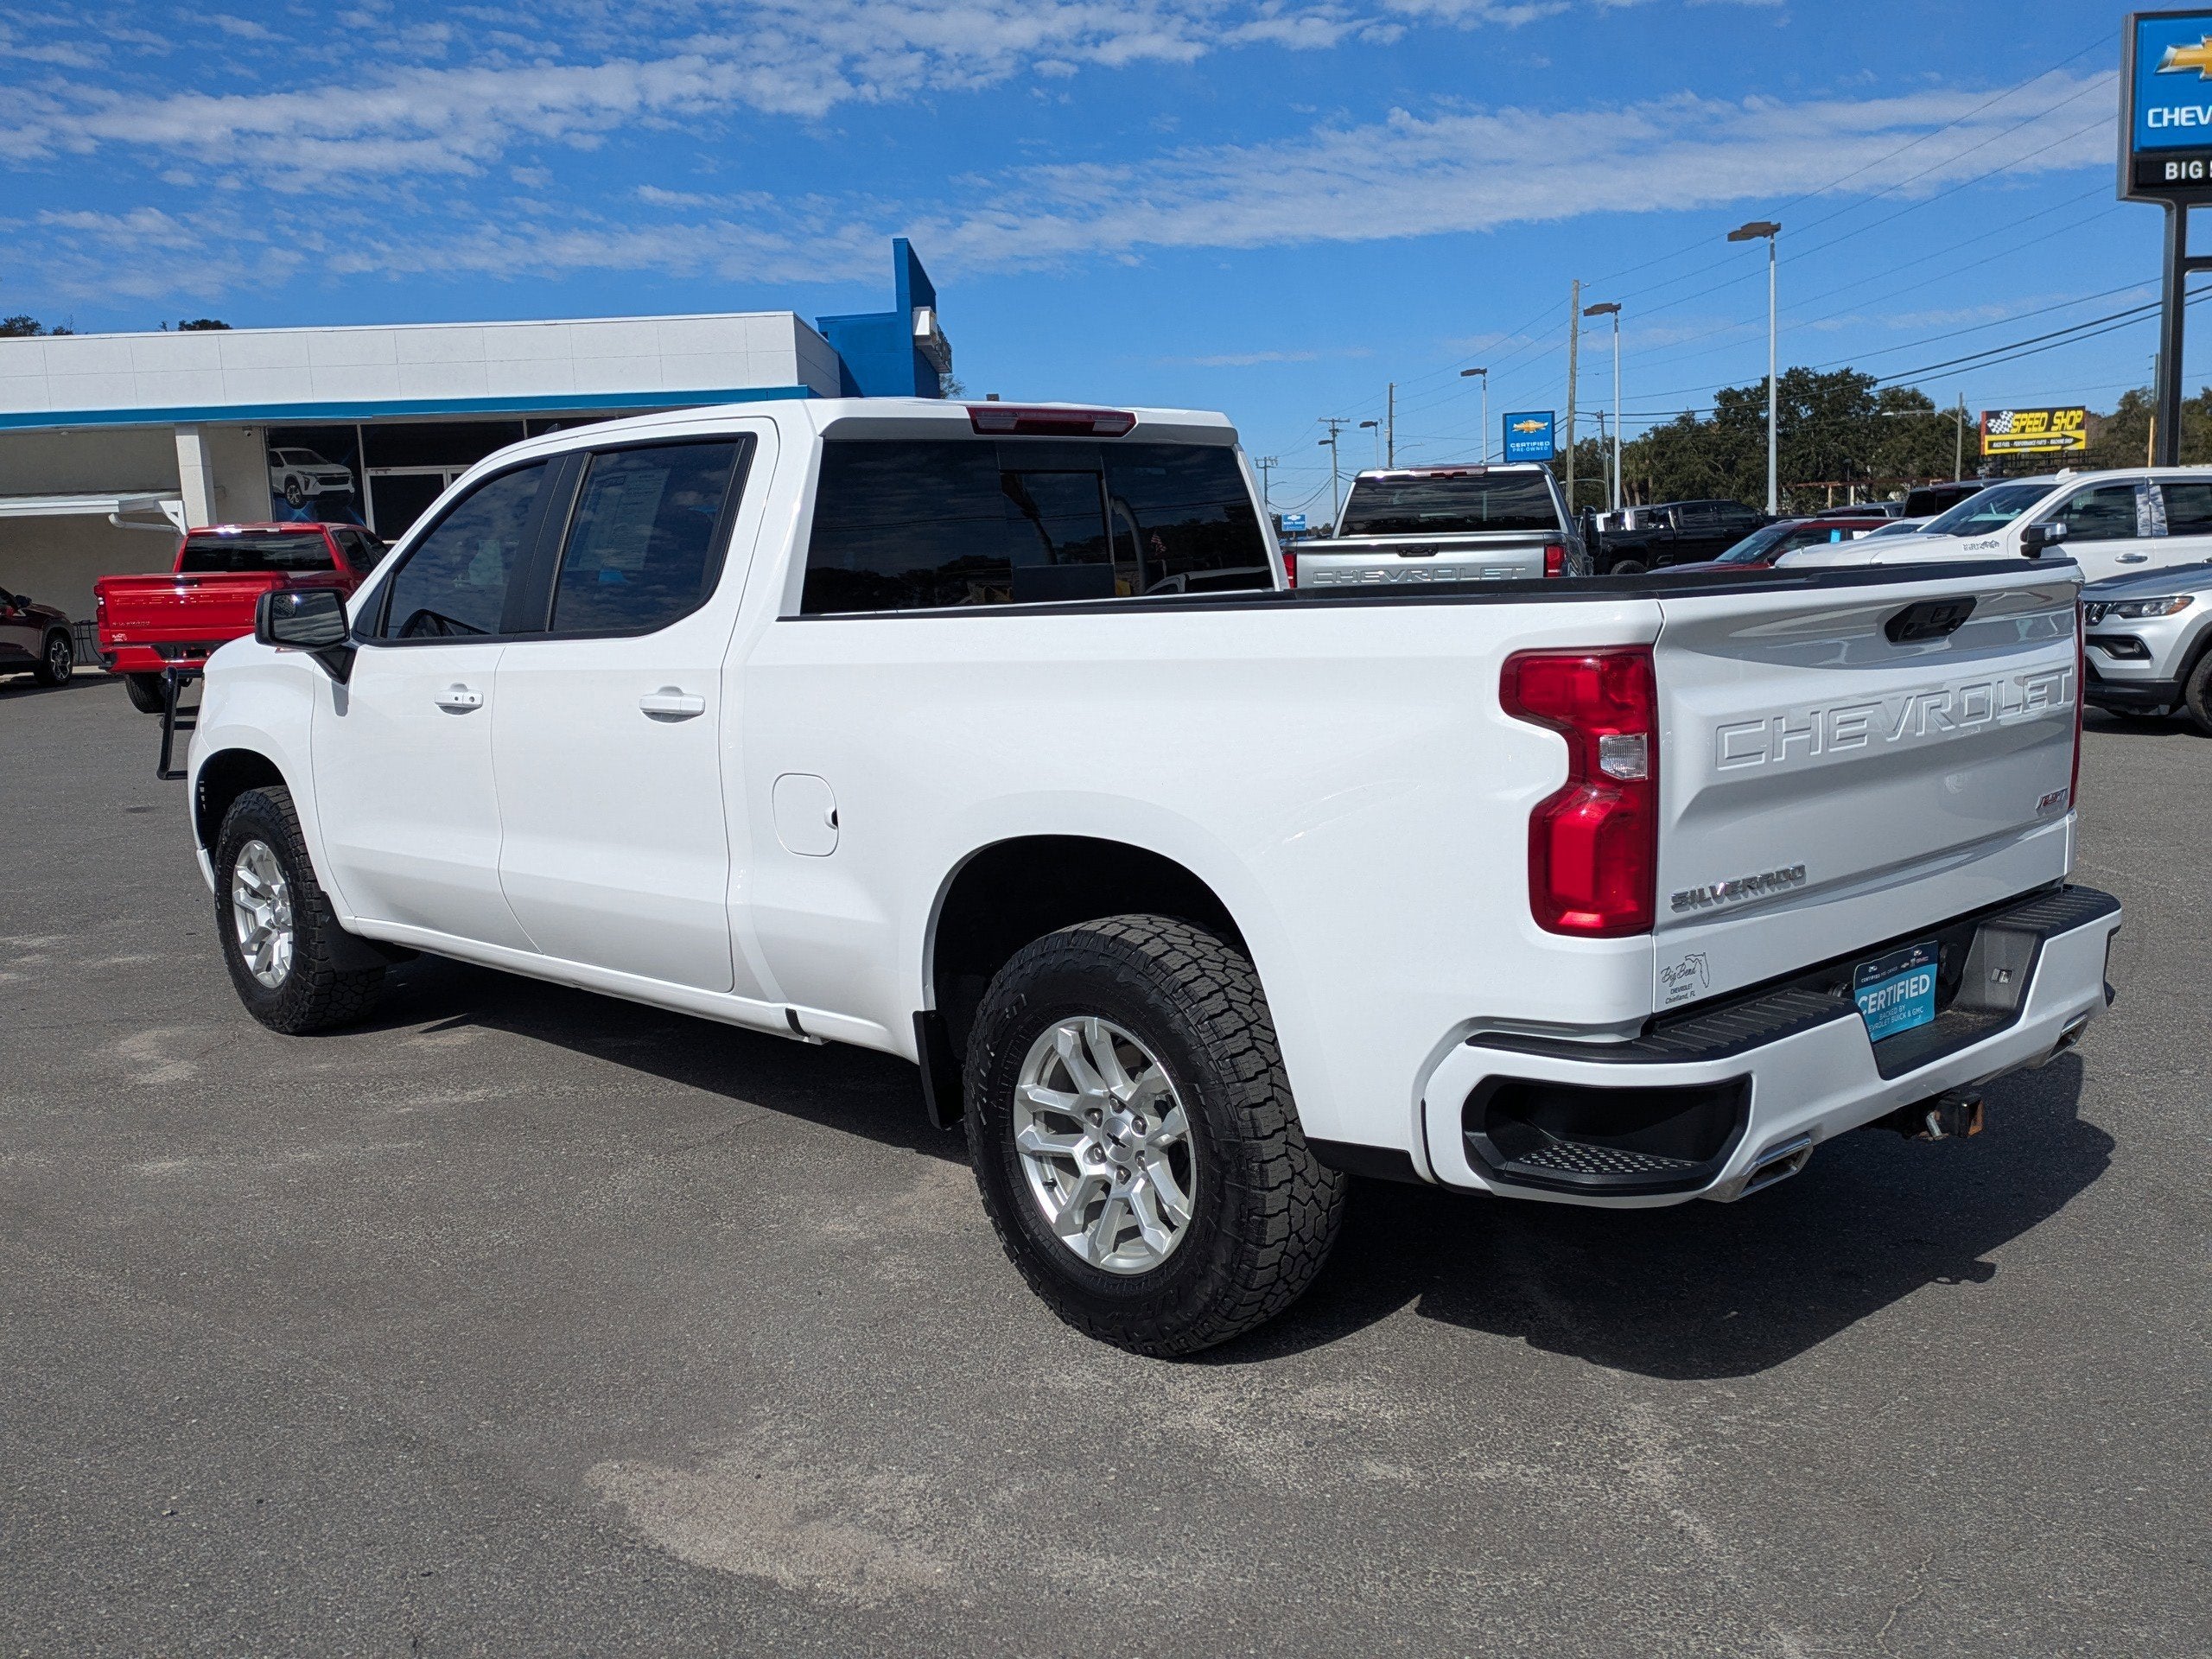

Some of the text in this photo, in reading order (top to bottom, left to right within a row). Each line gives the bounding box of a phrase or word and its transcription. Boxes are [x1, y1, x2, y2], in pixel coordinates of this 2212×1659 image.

[2147, 105, 2212, 128] CHEV
[2164, 160, 2203, 181] BIG
[2010, 410, 2083, 434] SPEED SHOP
[1313, 567, 1526, 584] CHEVROLET
[1715, 666, 2073, 771] CHEVROLET
[2037, 787, 2069, 810] RST
[1670, 864, 1806, 906] SILVERADO
[1660, 962, 1697, 987] Big Bend
[1860, 974, 1880, 983] CERTIFIED
[1858, 974, 1930, 1015] CERTIFIED
[1868, 1020, 1891, 1032] EVROLET
[1891, 1013, 1907, 1024] BUICK
[1911, 1006, 1924, 1015] GMC
[1878, 1003, 1906, 1020] BACKED BY
